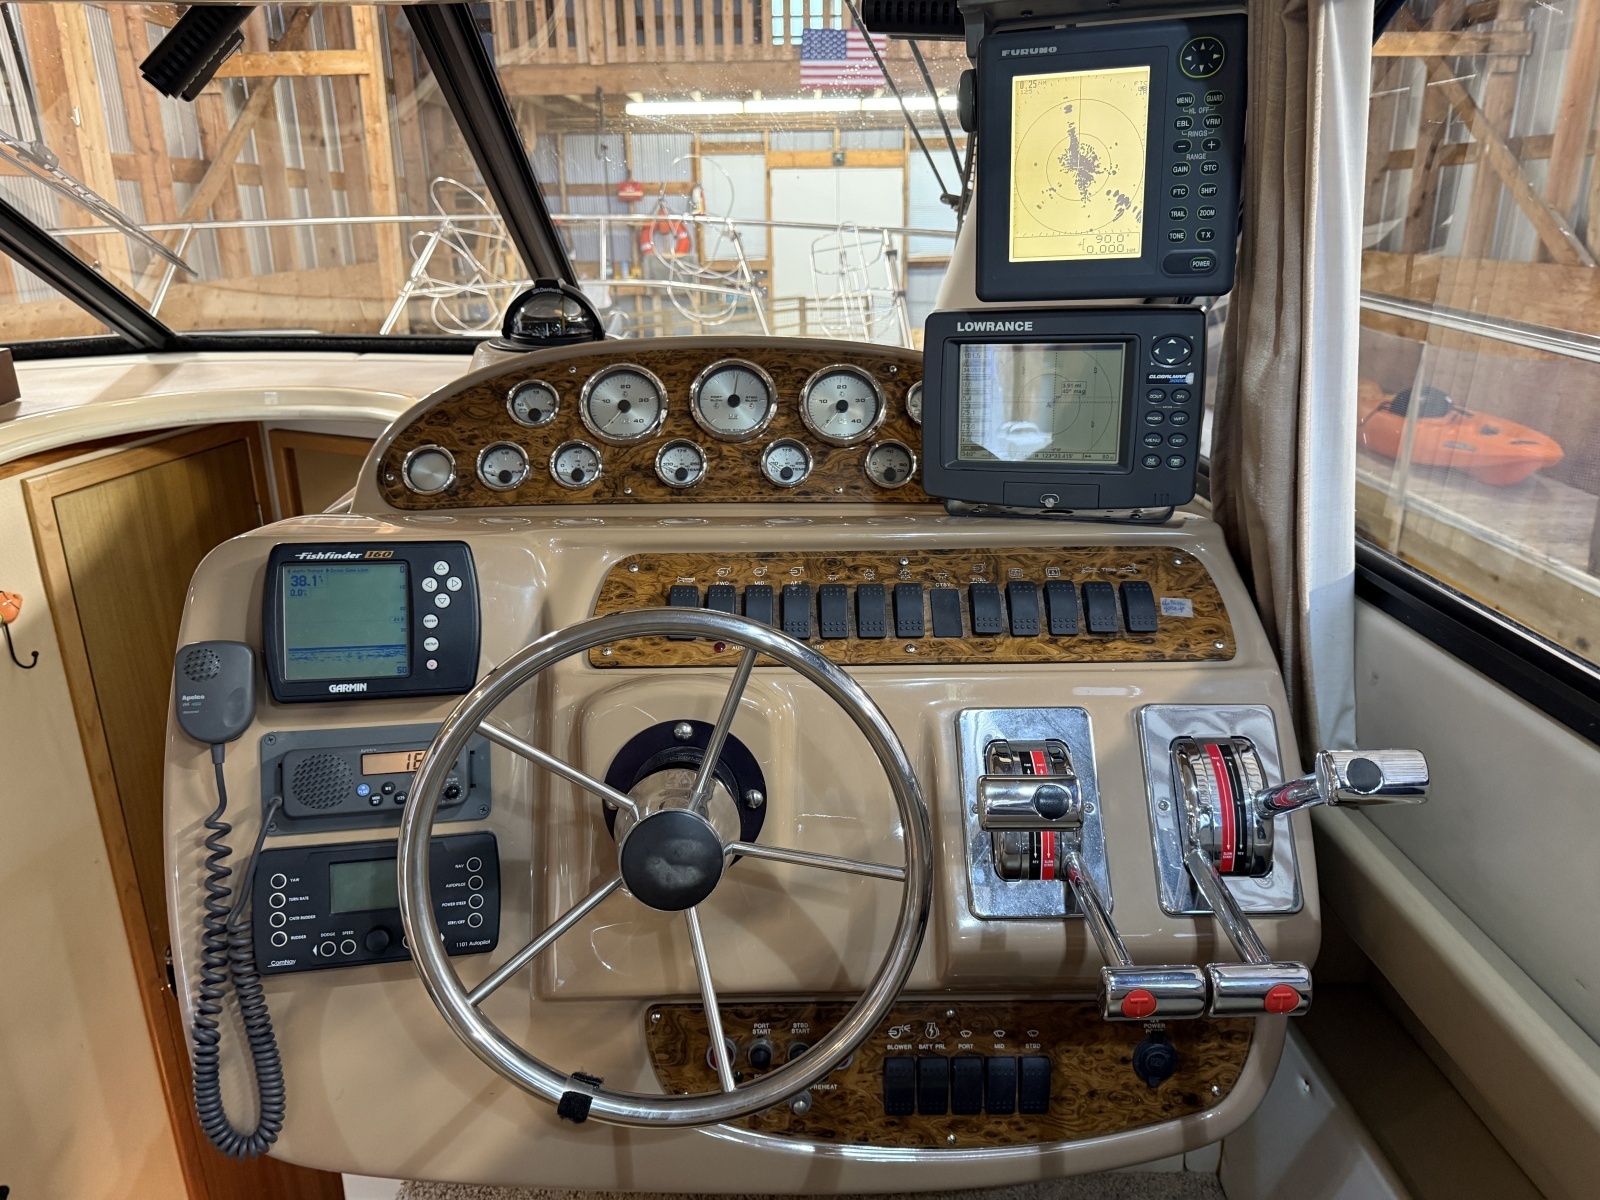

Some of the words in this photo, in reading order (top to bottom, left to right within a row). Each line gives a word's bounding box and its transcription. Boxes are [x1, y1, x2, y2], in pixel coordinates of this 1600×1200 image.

[1001, 46, 1058, 57] FURUNO
[1176, 96, 1193, 104] MENU
[1172, 188, 1186, 196] FTC
[1199, 209, 1215, 217] ZOOM
[956, 321, 1033, 332] LOWRANCE
[295, 551, 363, 560] Fishfinder
[290, 575, 317, 587] 38.1
[328, 682, 367, 693] GARMIN
[268, 959, 296, 967] ComNav
